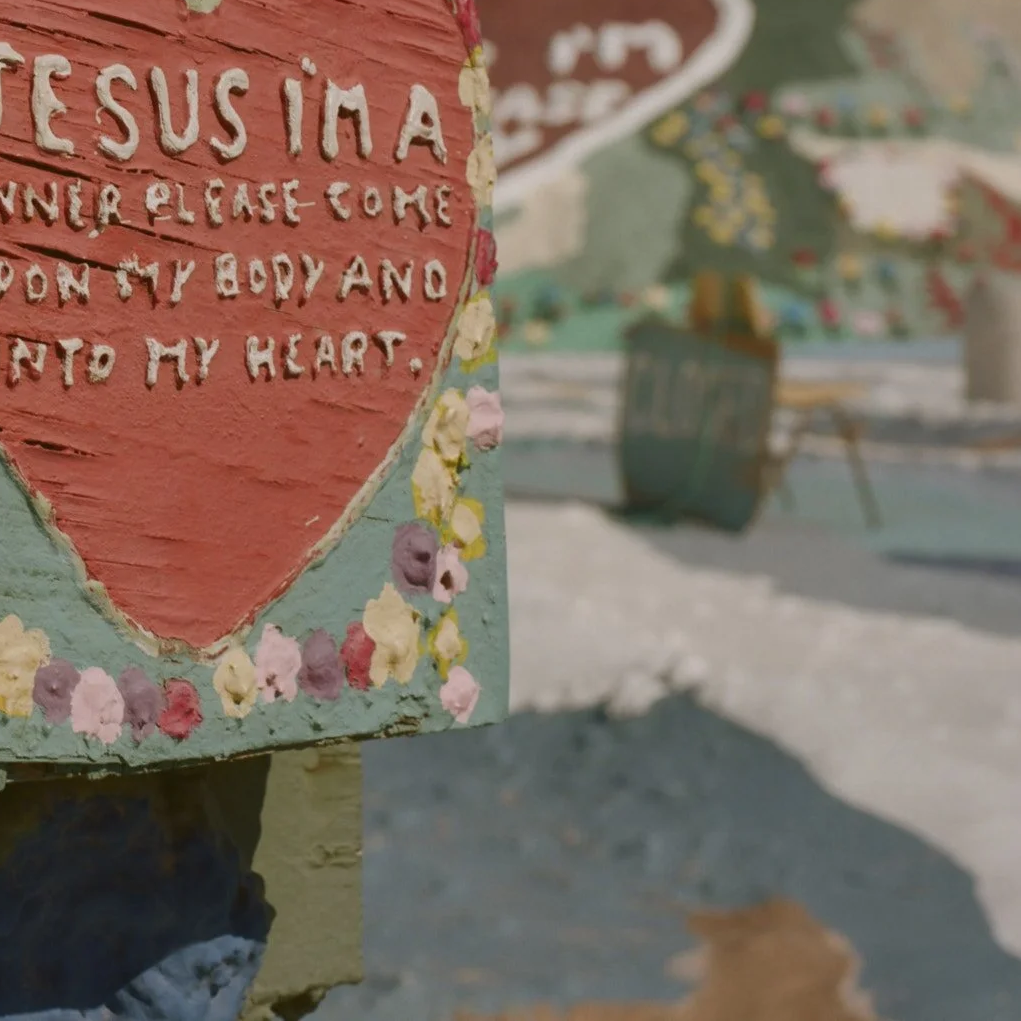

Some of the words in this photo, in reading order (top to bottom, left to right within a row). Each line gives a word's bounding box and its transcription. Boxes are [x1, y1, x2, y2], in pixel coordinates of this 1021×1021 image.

[395, 83, 448, 164] A
[145, 178, 308, 227] PLEASE
[324, 180, 454, 231] COME
[115, 254, 196, 305] MY
[214, 252, 325, 305] BODY
[337, 254, 448, 302] AND
[144, 337, 221, 386] MY
[245, 330, 423, 380] HEART.
